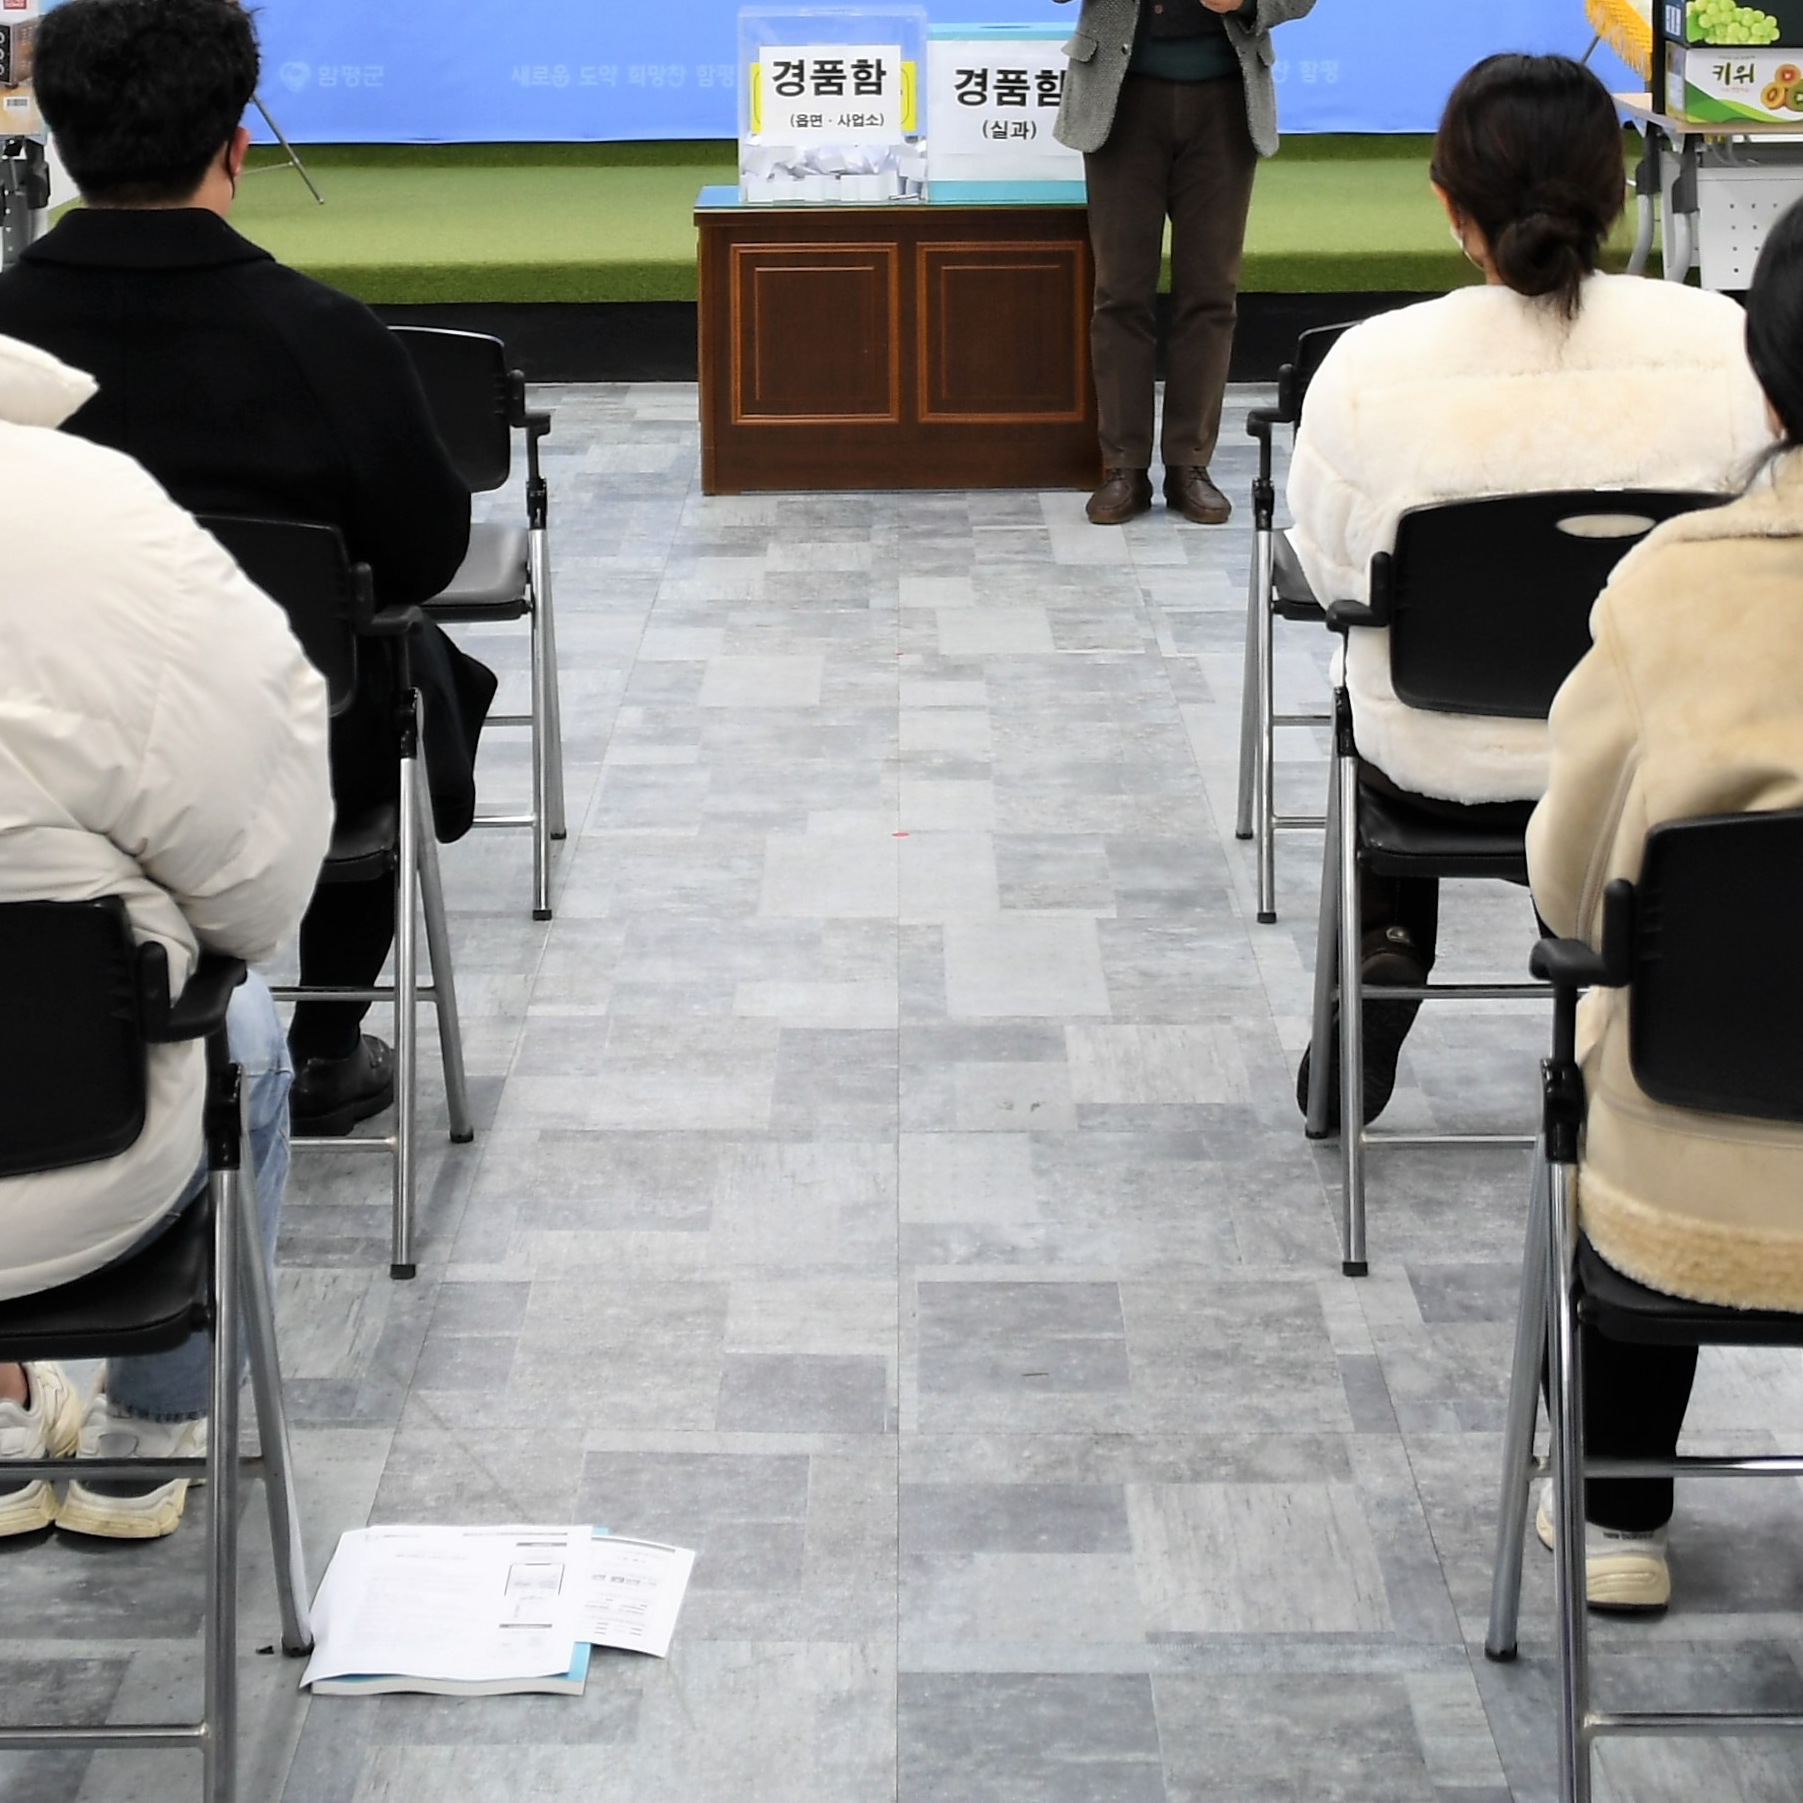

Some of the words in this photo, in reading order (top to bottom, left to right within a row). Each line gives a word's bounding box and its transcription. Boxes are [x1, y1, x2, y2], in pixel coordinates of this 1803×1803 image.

[318, 65, 384, 87] 함평군
[511, 64, 571, 88] 새로운
[578, 65, 618, 86] 도약
[628, 64, 687, 87] 희망찬
[773, 59, 886, 96] 경품함
[1712, 62, 1754, 86] 키위
[790, 113, 823, 128] (읍면
[838, 112, 885, 128] 사업소)
[982, 119, 1037, 140] (실과)
